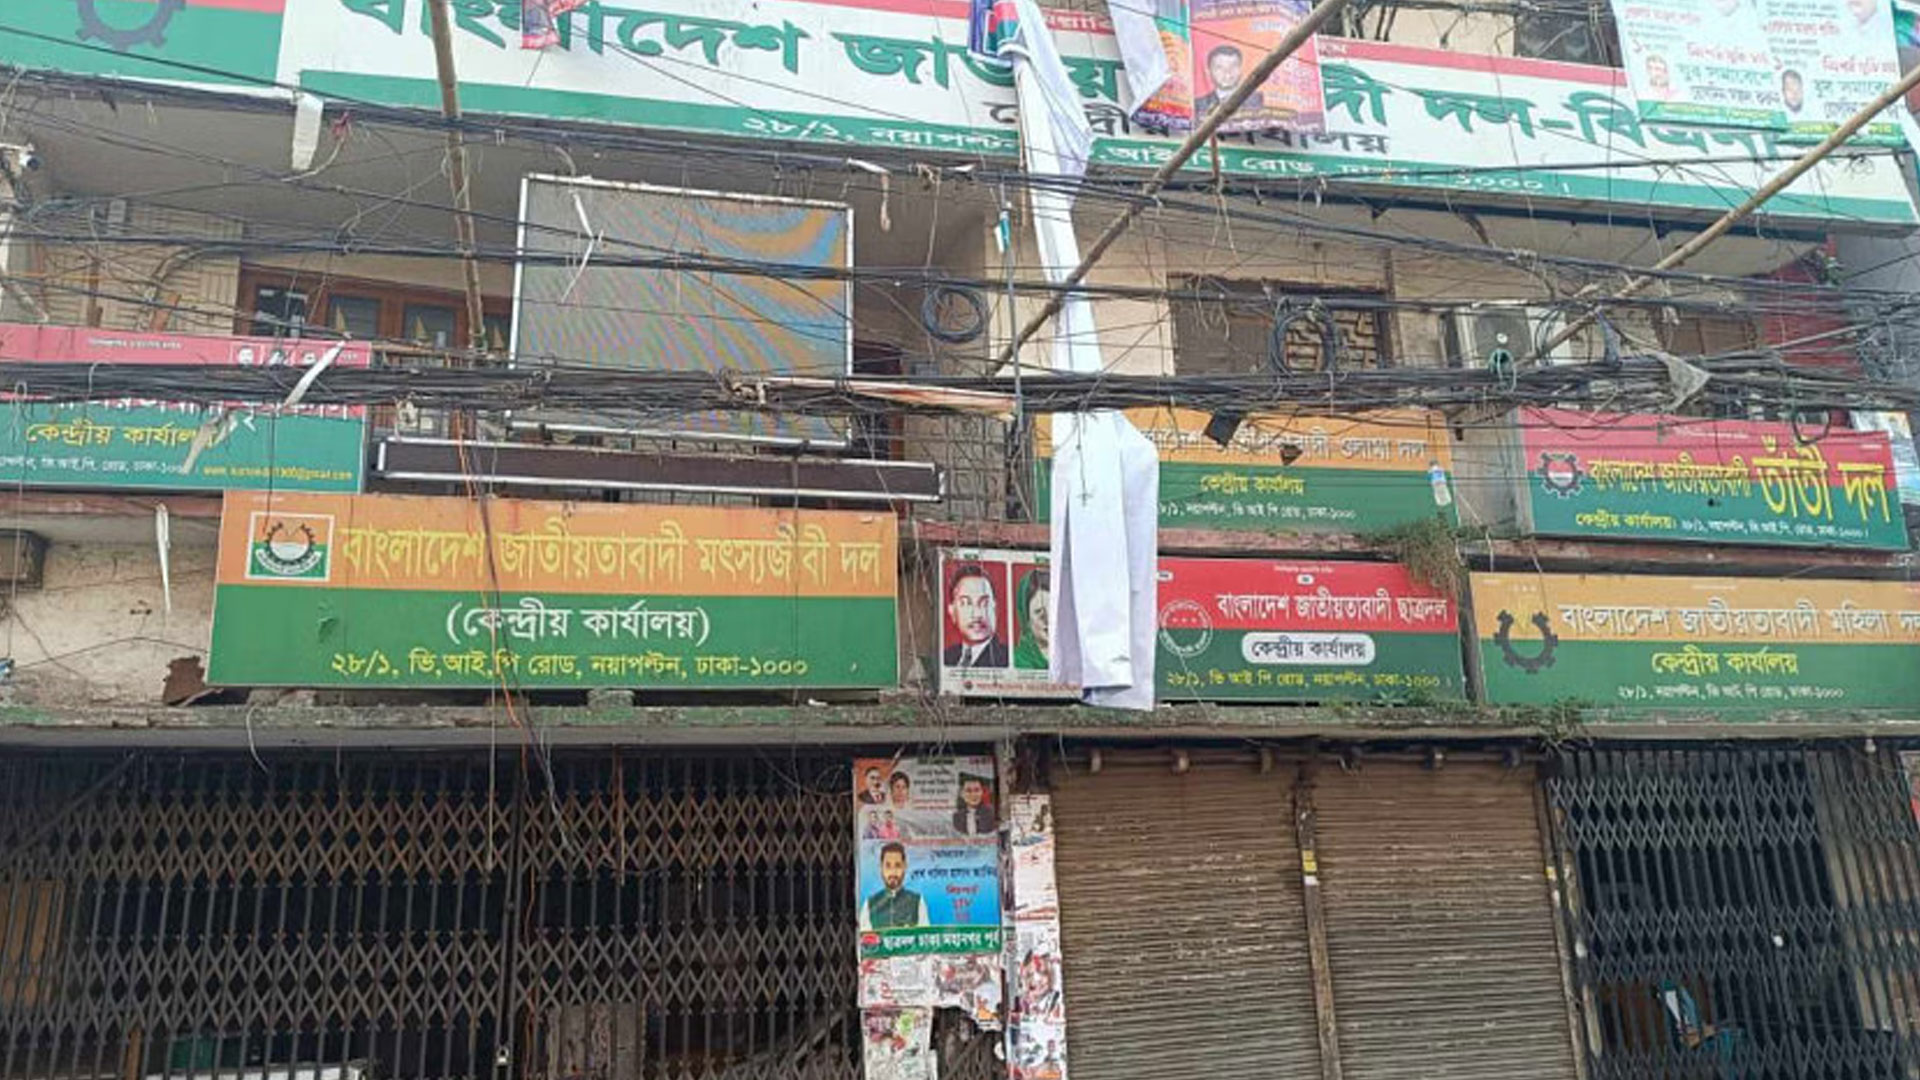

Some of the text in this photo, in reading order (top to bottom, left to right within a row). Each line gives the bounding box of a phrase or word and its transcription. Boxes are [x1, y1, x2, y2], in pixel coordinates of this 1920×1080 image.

[1837, 461, 1891, 524] দল
[336, 523, 487, 580] বাংলাদেশ
[497, 517, 688, 583] জাতীয়তাবাদী
[840, 540, 884, 586] দল
[580, 599, 711, 646] কার্যালয়)
[1214, 592, 1290, 622] বাংলাদেশ
[1293, 585, 1392, 623] জাতীয়তাবাদী
[1557, 603, 1672, 637] বাংলাদেশ
[1677, 595, 1821, 638] জাতীয়তাবাদী
[694, 655, 808, 678] ঢাকা-১০০০
[1251, 634, 1367, 660] কেন্দ্রীয় কার্যালয়
[1651, 643, 1799, 677] কেন্দ্রীয় কার্যালয়
